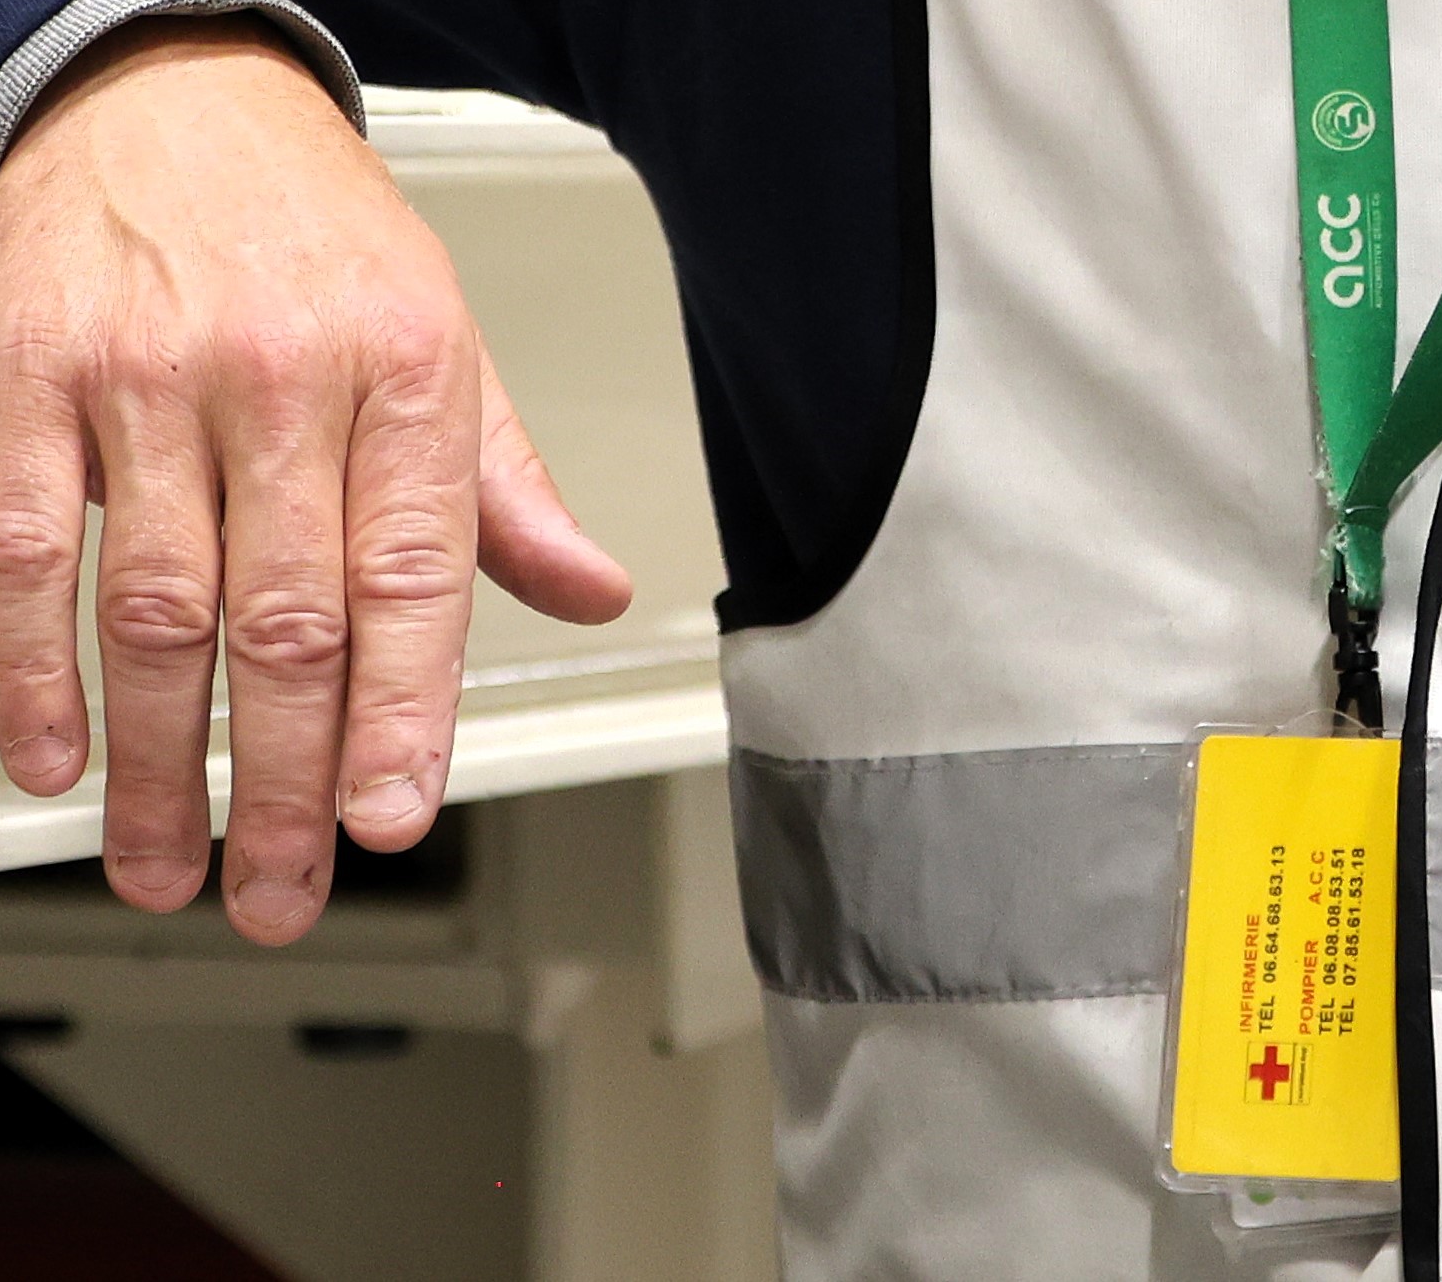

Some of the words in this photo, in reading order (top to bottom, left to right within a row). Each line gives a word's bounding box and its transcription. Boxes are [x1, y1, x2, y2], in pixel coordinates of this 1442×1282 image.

[1317, 193, 1364, 308] acc
[1308, 850, 1325, 905] A.C.C
[1239, 914, 1260, 1033] INFIRMERIE
[1299, 940, 1319, 1035] POMPIER
[1257, 996, 1276, 1034] TÉL
[1316, 997, 1335, 1035] TÉL
[1337, 998, 1355, 1036] TÉL
